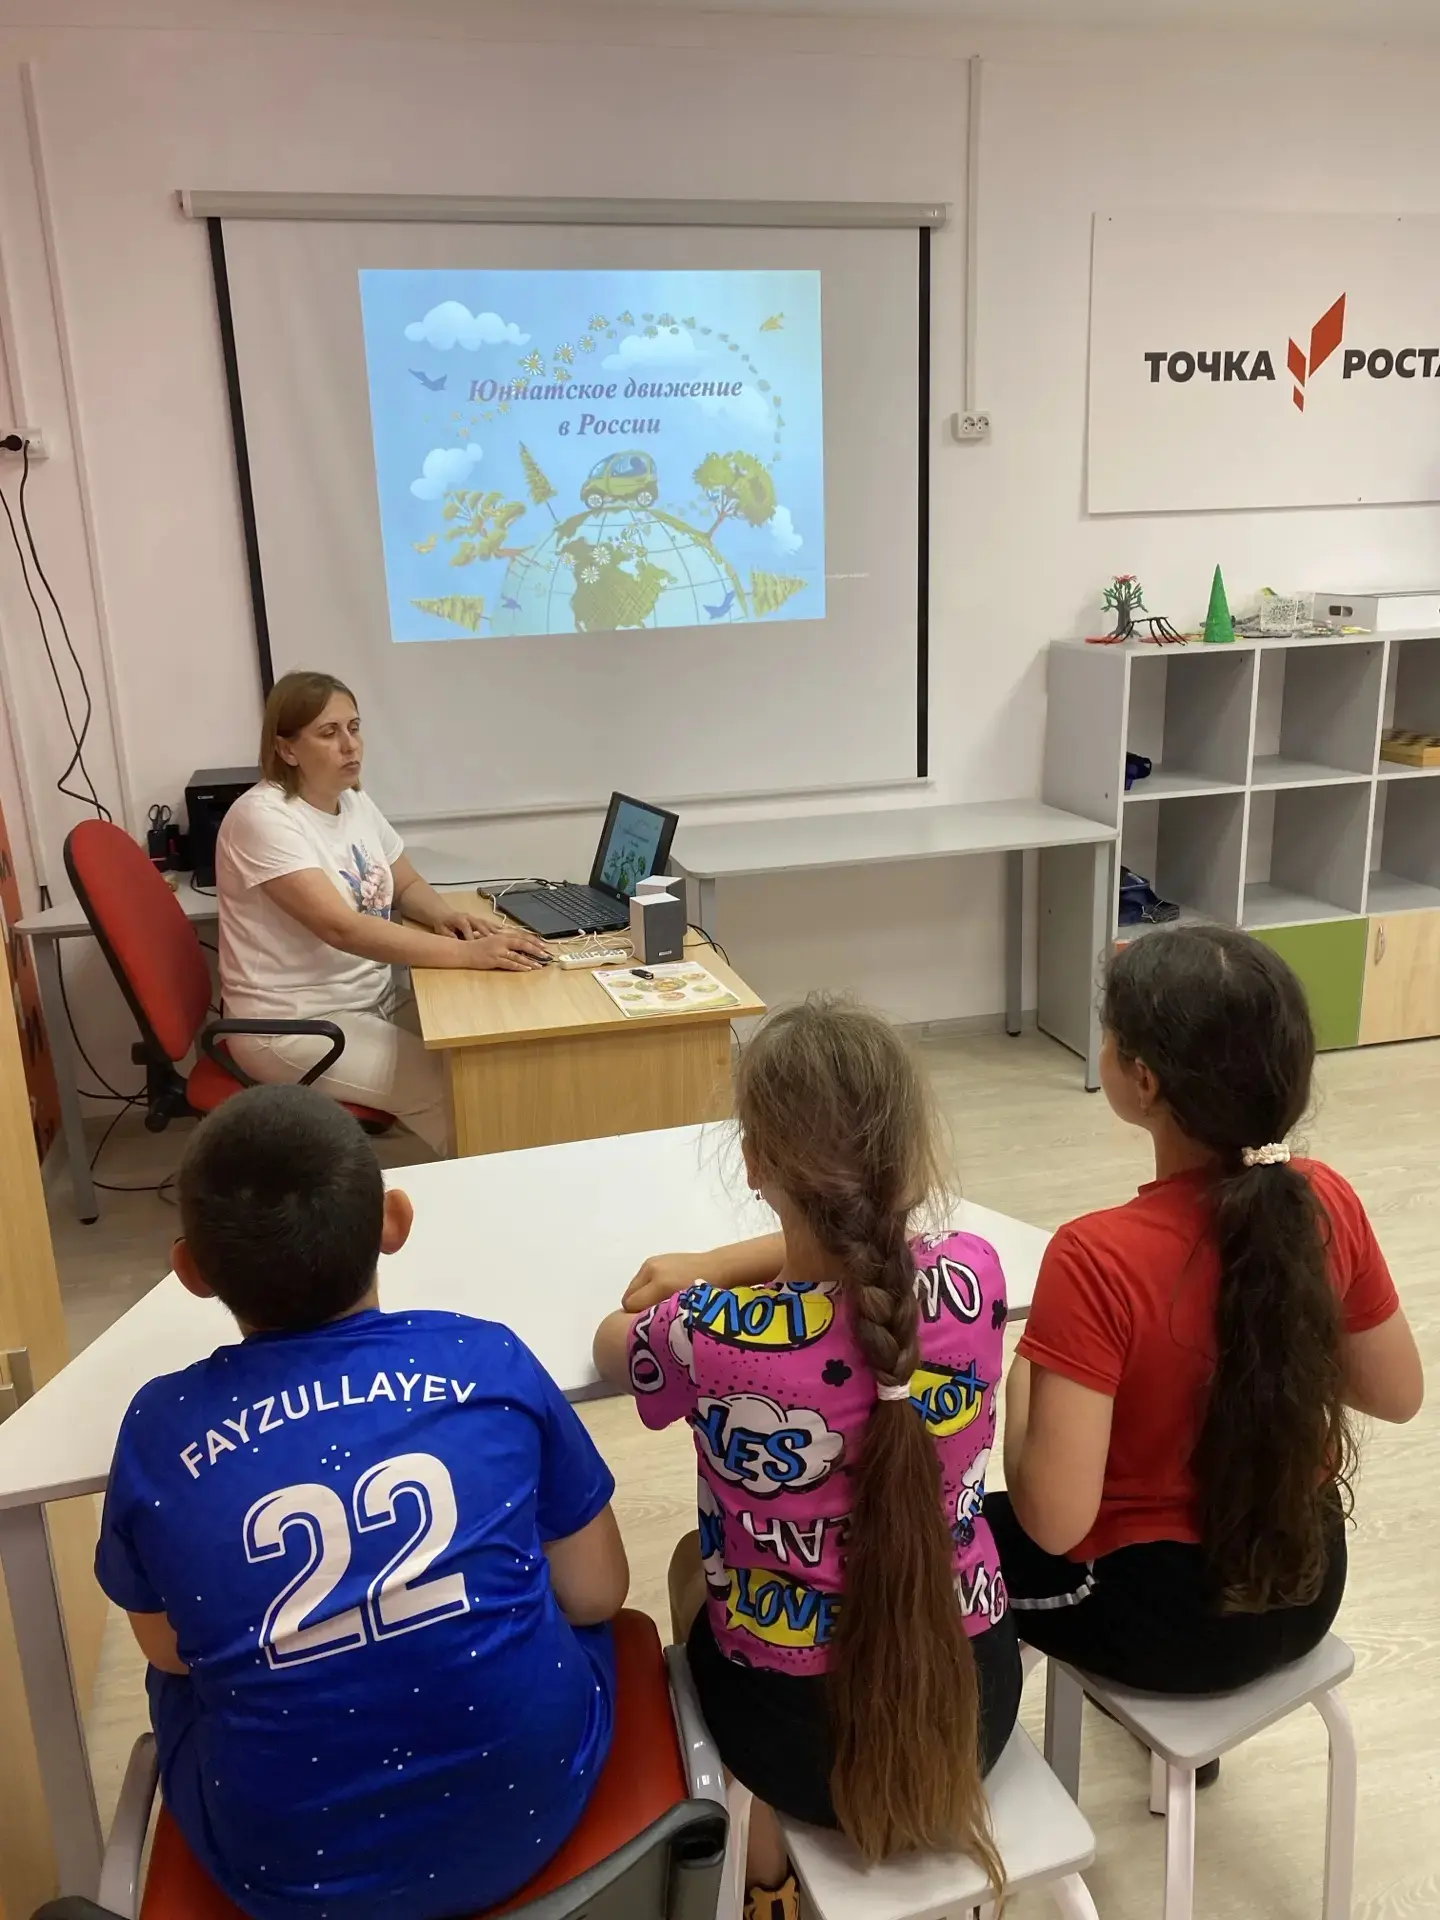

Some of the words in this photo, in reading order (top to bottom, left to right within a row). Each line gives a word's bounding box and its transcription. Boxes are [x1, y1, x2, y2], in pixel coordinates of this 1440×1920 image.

[624, 377, 743, 399] движение
[1145, 350, 1276, 383] ТОЧКА
[1343, 348, 1440, 380] РОСТ
[558, 418, 571, 436] в
[577, 413, 661, 436] России
[178, 1371, 477, 1480] FAYZULLAYEV
[691, 1405, 812, 1482] YES
[242, 1452, 470, 1670] 22
[735, 1568, 842, 1645] LOVE
